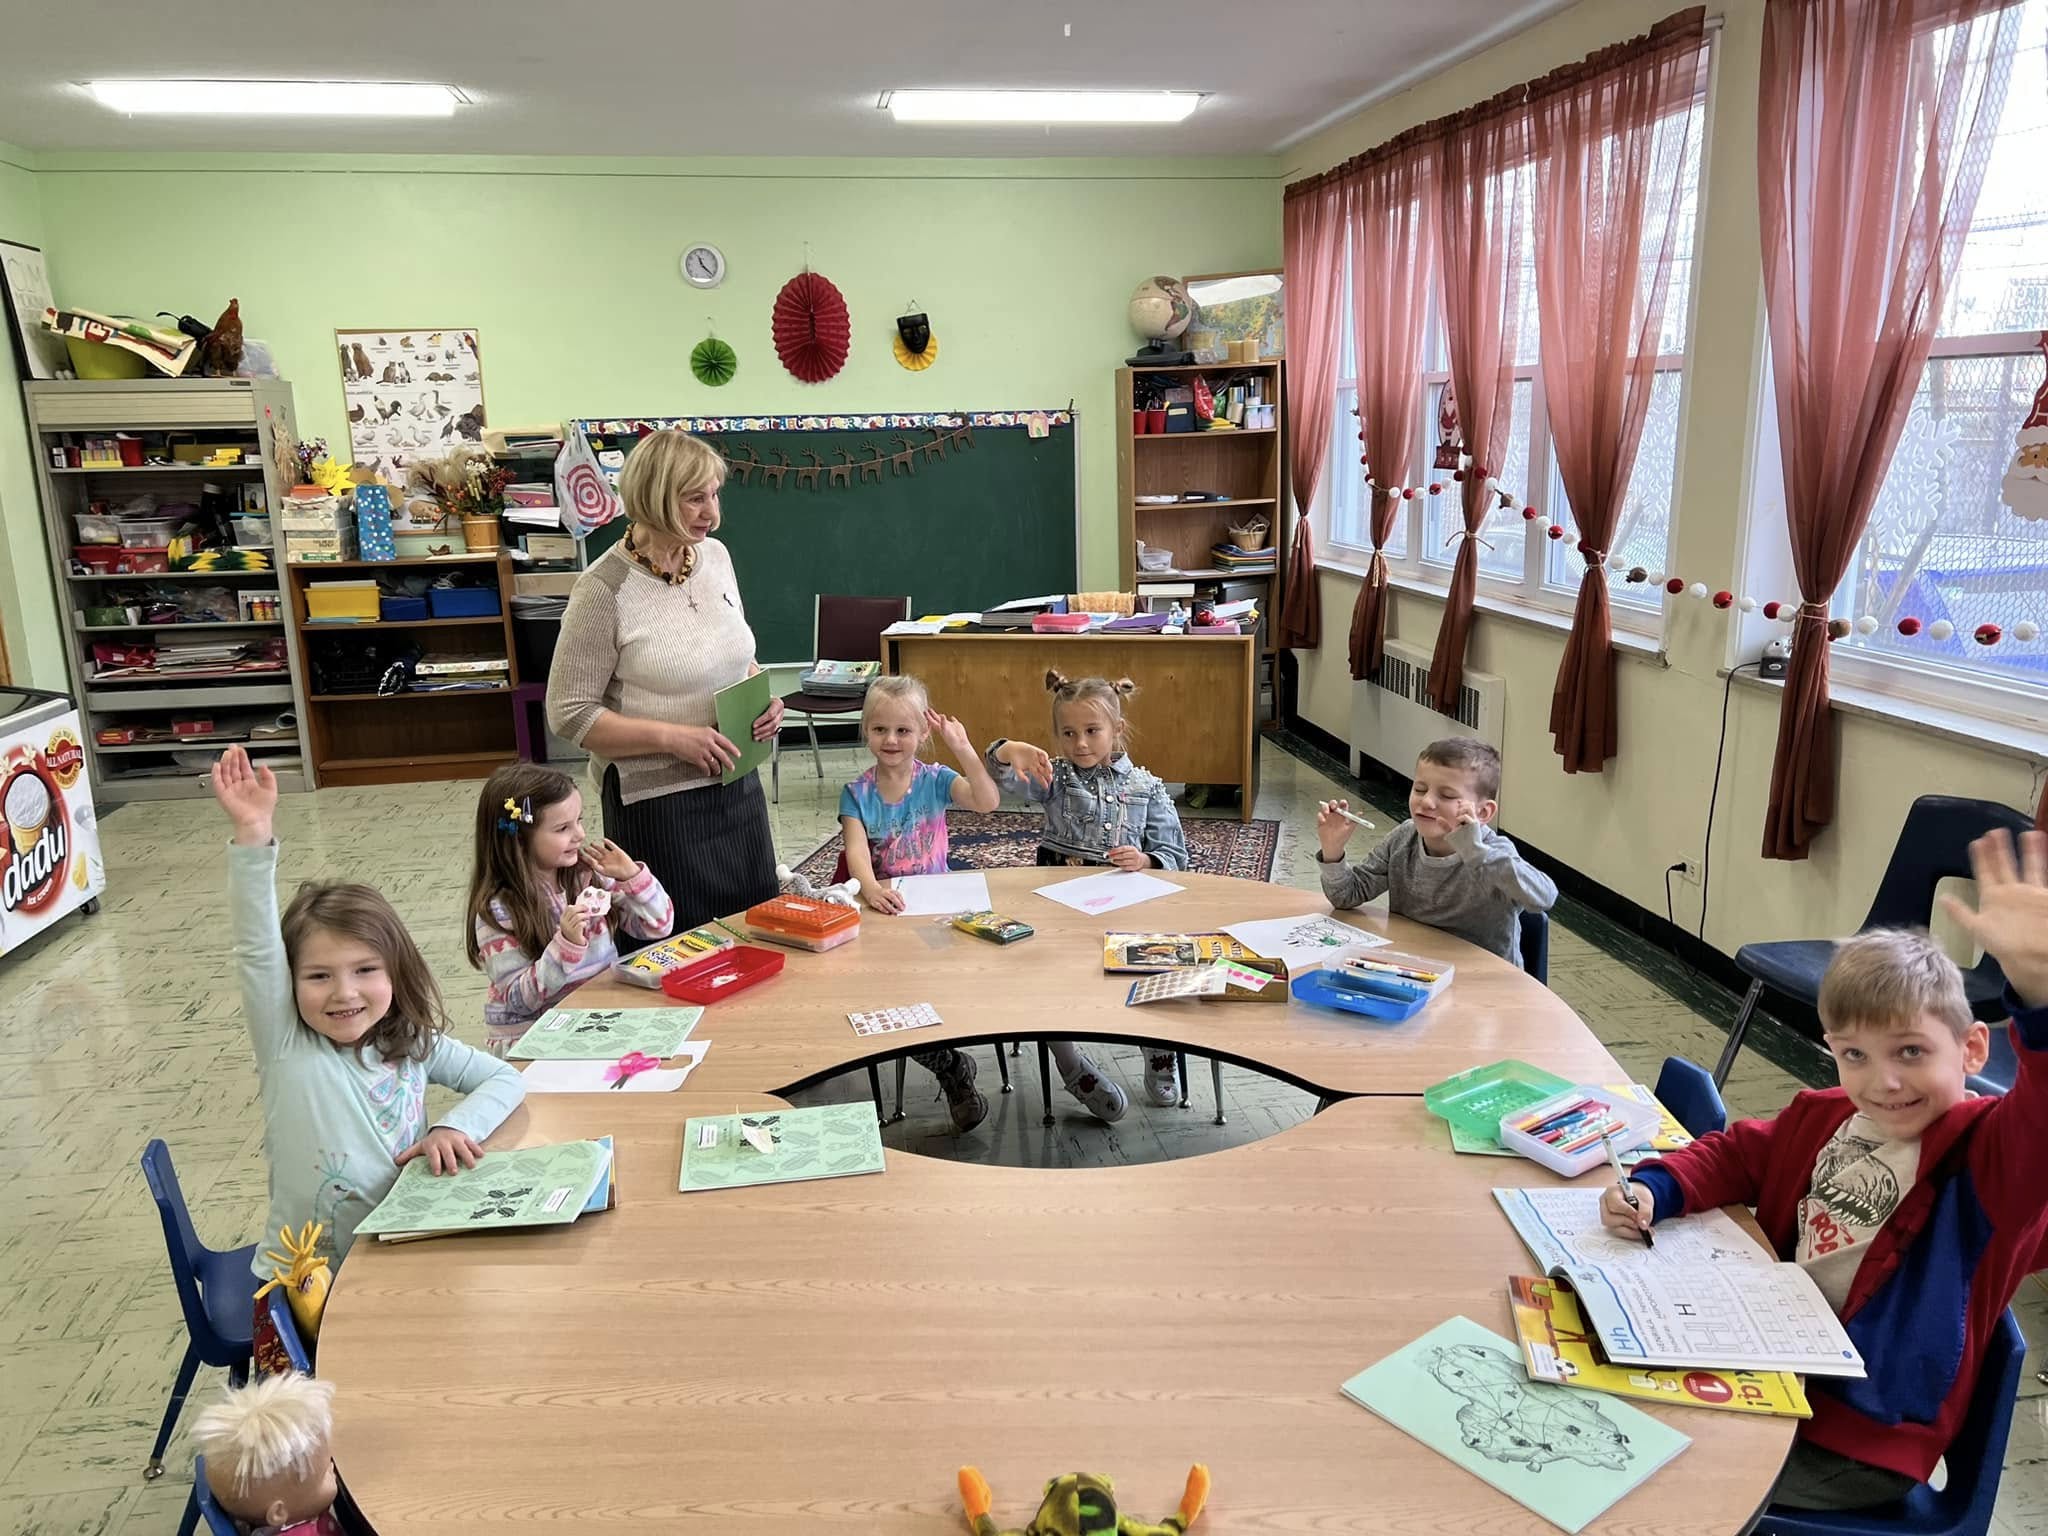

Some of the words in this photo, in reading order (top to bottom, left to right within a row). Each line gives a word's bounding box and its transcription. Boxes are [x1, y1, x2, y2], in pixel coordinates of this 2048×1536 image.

[3, 825, 65, 910] dadu
[1673, 1303, 1697, 1316] H
[1609, 1326, 1635, 1351] Hh
[1699, 1380, 1729, 1394] 1
